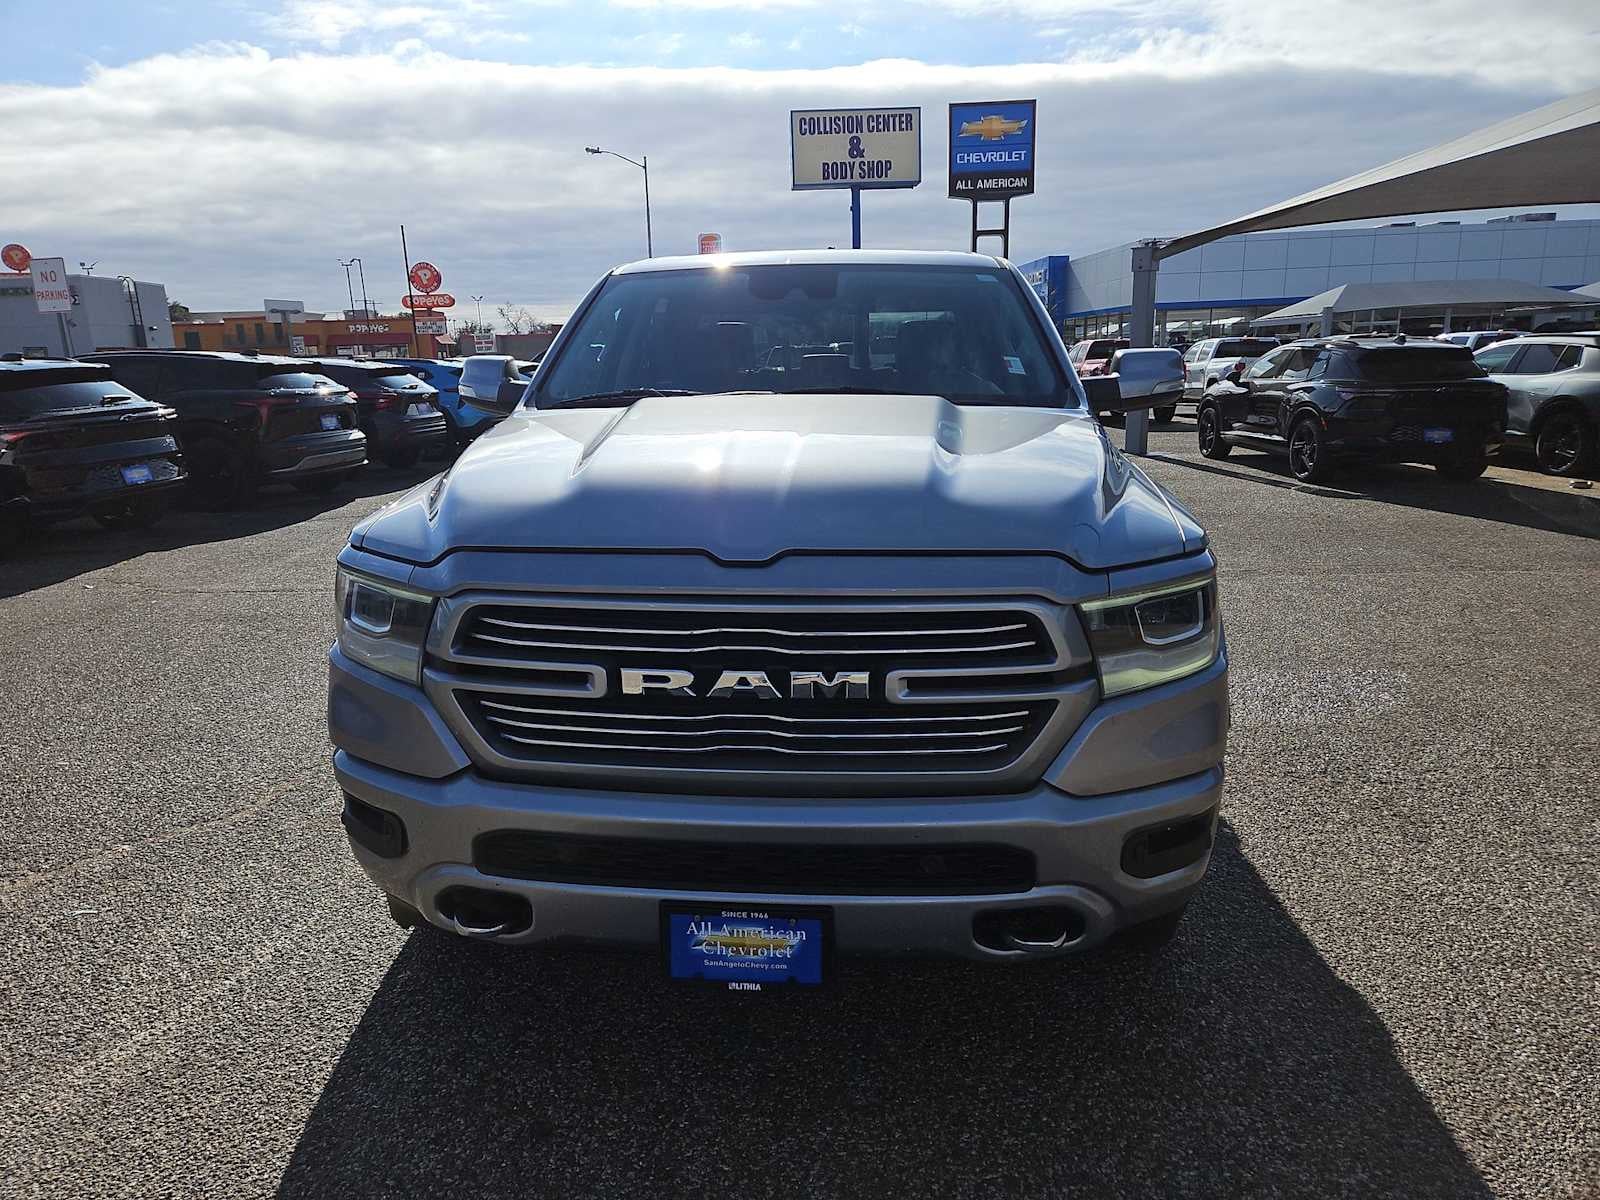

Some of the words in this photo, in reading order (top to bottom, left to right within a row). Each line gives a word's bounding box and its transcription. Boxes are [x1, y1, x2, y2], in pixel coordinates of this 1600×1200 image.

[799, 115, 864, 136] COLLISION
[866, 113, 913, 133] CENTER
[848, 135, 865, 159] &
[956, 150, 1027, 164] CHEVROLET
[822, 160, 857, 181] BODY
[858, 159, 892, 179] SHOP
[956, 179, 975, 190] ALL
[976, 177, 1028, 189] AMERICAN
[40, 270, 57, 283] NO
[36, 289, 69, 300] PARKING
[620, 667, 870, 700] RAM
[721, 910, 748, 919] SINCE
[749, 911, 769, 919] 1966
[686, 921, 712, 936] All
[720, 923, 807, 941] American
[702, 940, 793, 959] Chevrolet
[703, 959, 788, 971] SanAngeloChevy.com
